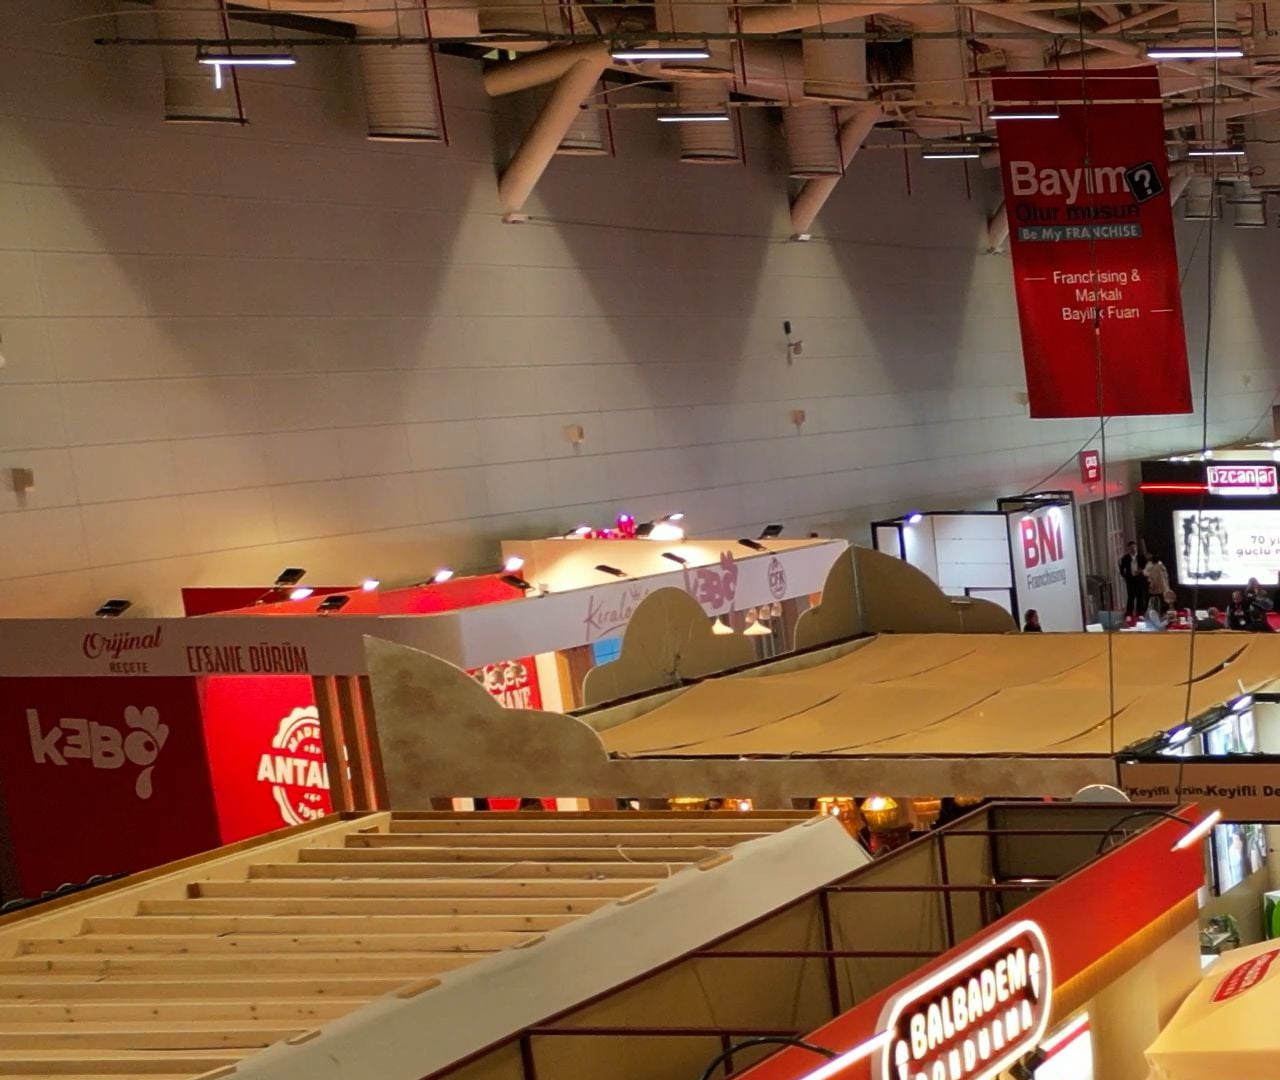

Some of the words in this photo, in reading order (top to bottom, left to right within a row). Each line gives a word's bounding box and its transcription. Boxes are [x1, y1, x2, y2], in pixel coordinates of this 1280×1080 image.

[1023, 229, 1037, 240] Be
[1042, 228, 1062, 242] My
[1066, 225, 1138, 239] FRANCHISE
[1053, 270, 1127, 286] Franchising
[1131, 269, 1141, 282] &
[1020, 516, 1064, 569] BNI
[1250, 535, 1265, 545] 70
[83, 625, 162, 660] Orijinal
[186, 646, 245, 673] EFSANE
[250, 642, 309, 672] DÜRÜM
[911, 948, 1027, 1060] BALBADEM
